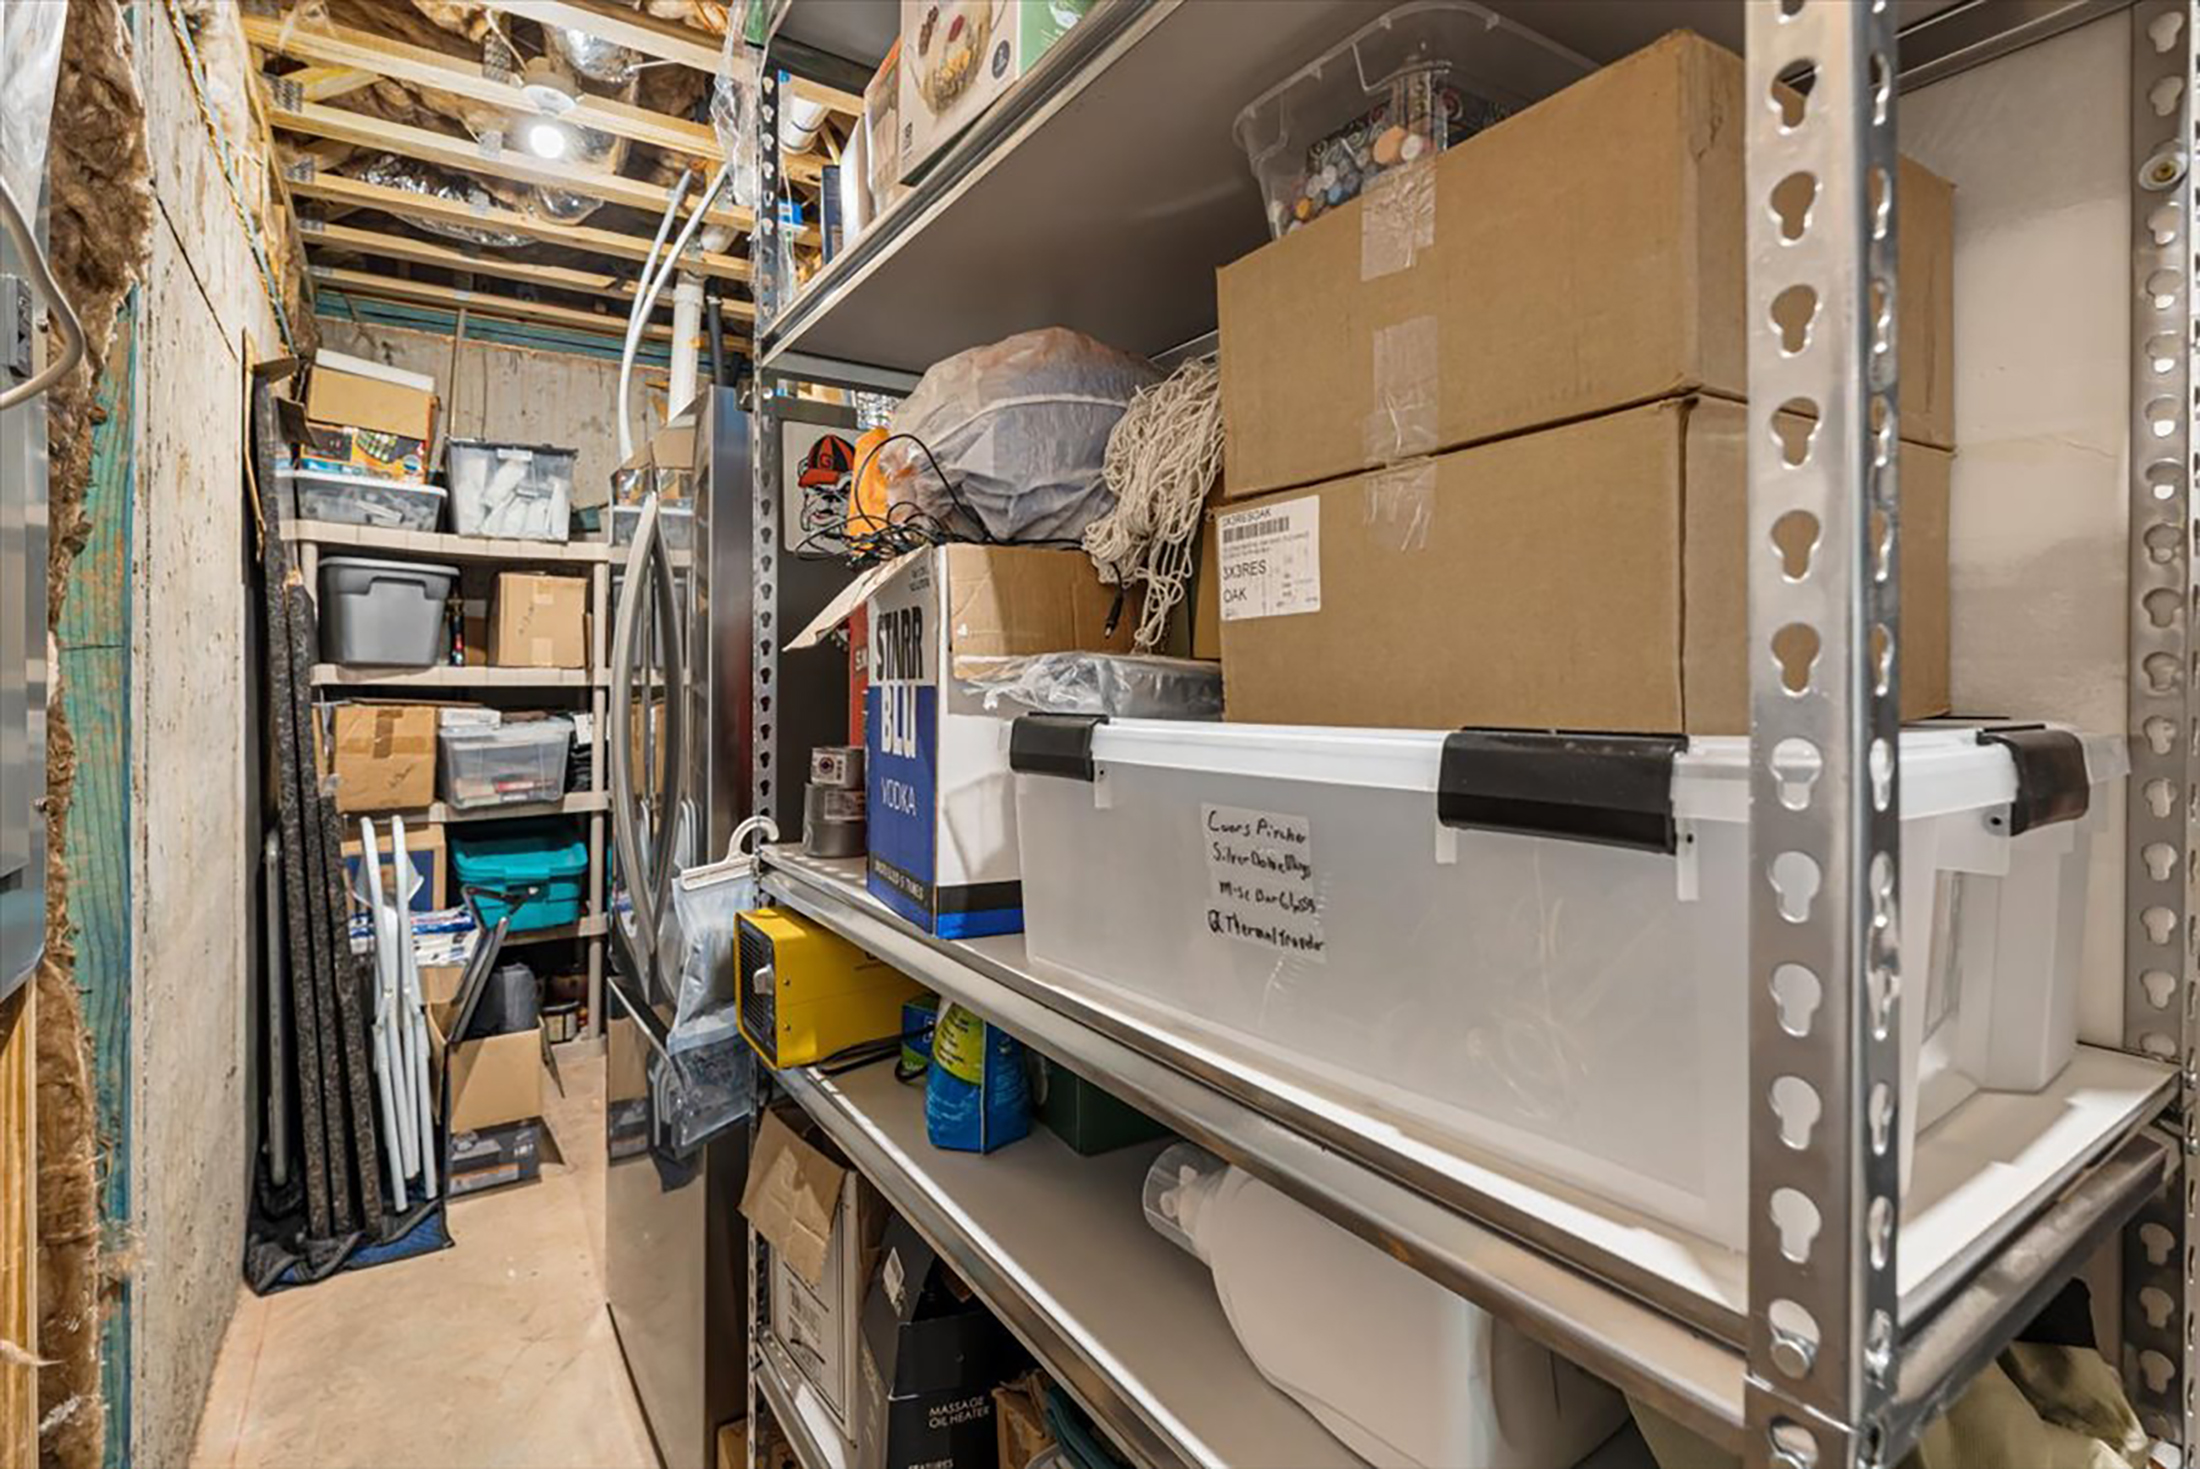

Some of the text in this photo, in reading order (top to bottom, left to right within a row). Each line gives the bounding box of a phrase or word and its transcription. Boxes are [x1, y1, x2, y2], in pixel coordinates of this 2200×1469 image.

[1223, 587, 1247, 603] OAK
[876, 606, 923, 681] STARR
[881, 686, 917, 759] BLU
[880, 776, 917, 817] VODKA
[929, 1396, 985, 1418] MASSAGE
[949, 1405, 990, 1425] HEATER
